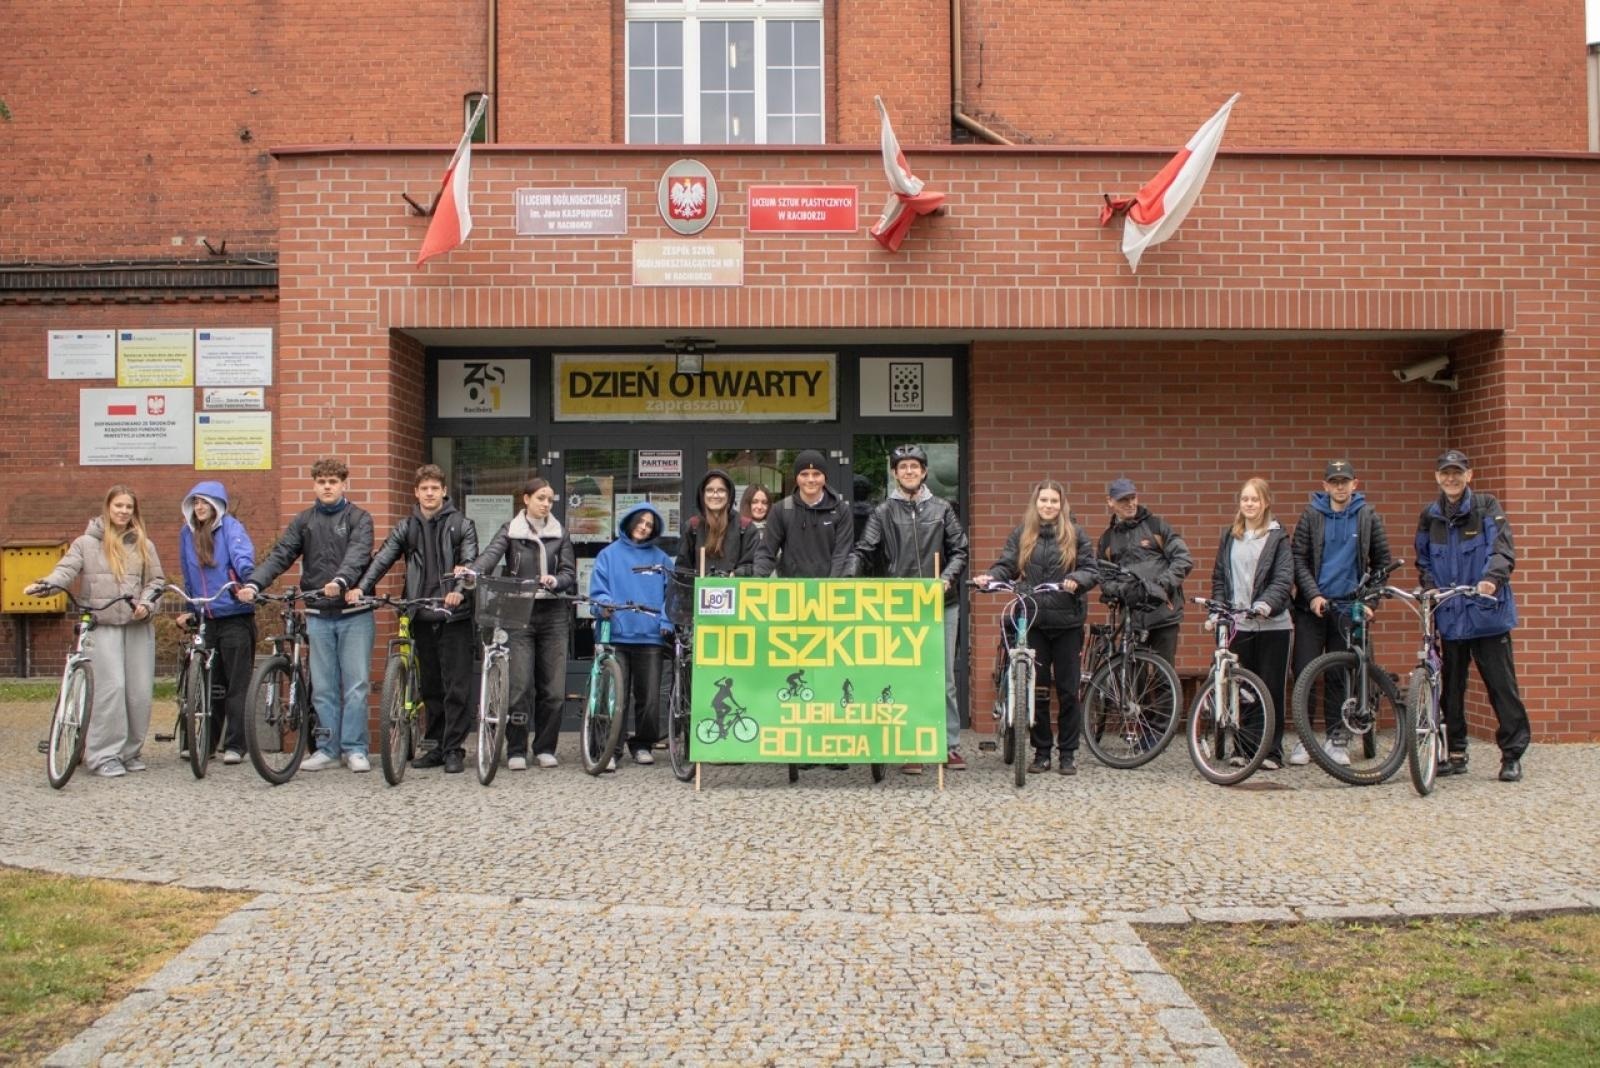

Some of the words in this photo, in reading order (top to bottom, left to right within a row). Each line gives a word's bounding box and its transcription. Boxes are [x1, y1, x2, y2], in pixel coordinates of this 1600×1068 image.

[525, 194, 551, 205] LICEUM
[552, 192, 621, 207] OGÓLNOKSZTAŁCĄCE
[752, 198, 776, 207] LICEUM
[778, 198, 799, 207] SZTUK
[801, 198, 852, 207] PLASTYCZNYCH
[544, 210, 560, 218] Jana
[562, 209, 613, 218] KASPROWICZA
[778, 211, 786, 220] W
[787, 211, 826, 220] RACIBORZU
[663, 245, 690, 255] ZESPÓŁ
[692, 245, 715, 255] SZKÓŁ
[665, 272, 672, 280] W
[569, 366, 660, 398] DZIEŃ
[669, 370, 823, 398] OTWARTY
[894, 392, 919, 402] LSP
[645, 400, 746, 414] zapraszamy
[738, 582, 943, 622] ROWEREM
[696, 625, 755, 666] DO
[768, 626, 930, 667] SZKOŁY
[780, 702, 908, 725] JUBILEUSZ
[760, 727, 802, 757] 80
[807, 735, 870, 757] LECIA
